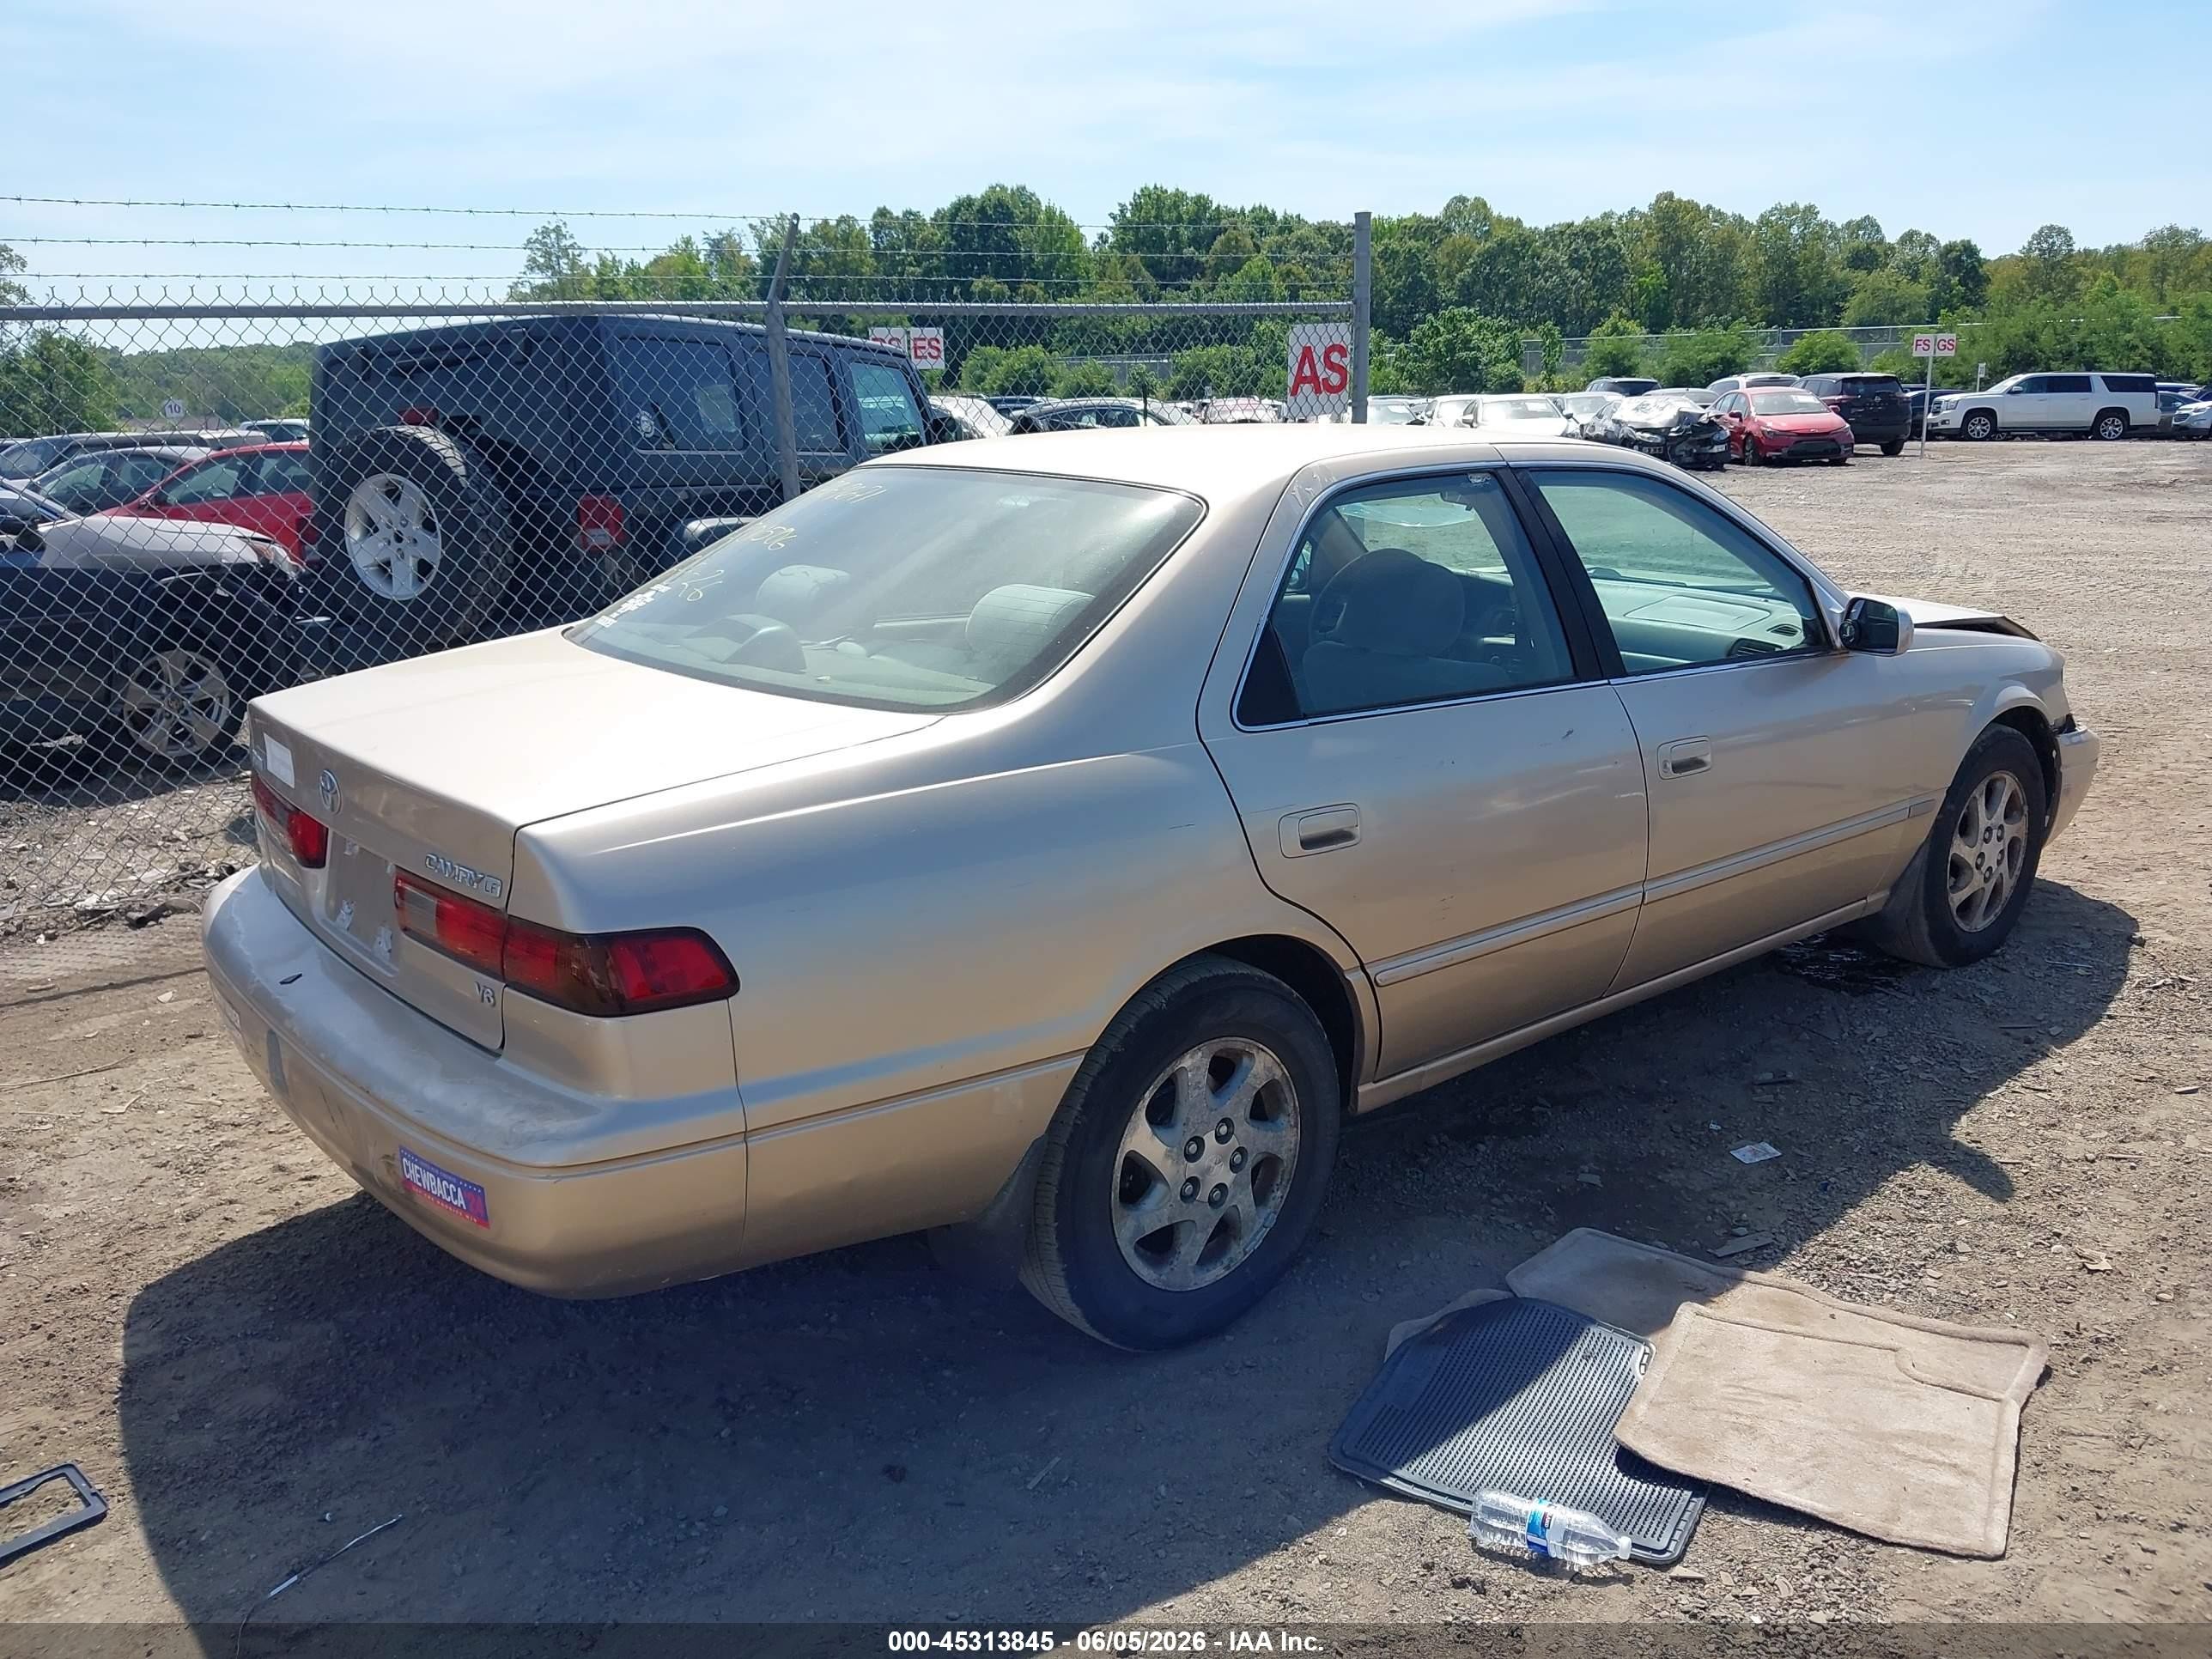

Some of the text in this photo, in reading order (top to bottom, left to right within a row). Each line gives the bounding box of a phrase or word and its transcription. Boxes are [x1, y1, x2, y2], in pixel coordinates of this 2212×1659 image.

[912, 336, 942, 361] ES
[1914, 338, 1931, 352] FS
[1936, 338, 1955, 351] GS
[1290, 343, 1348, 397] AS
[167, 404, 181, 414] 10
[425, 853, 485, 889] CAMRY
[473, 981, 496, 1007] V6
[402, 1157, 467, 1210] CHEWBACCA
